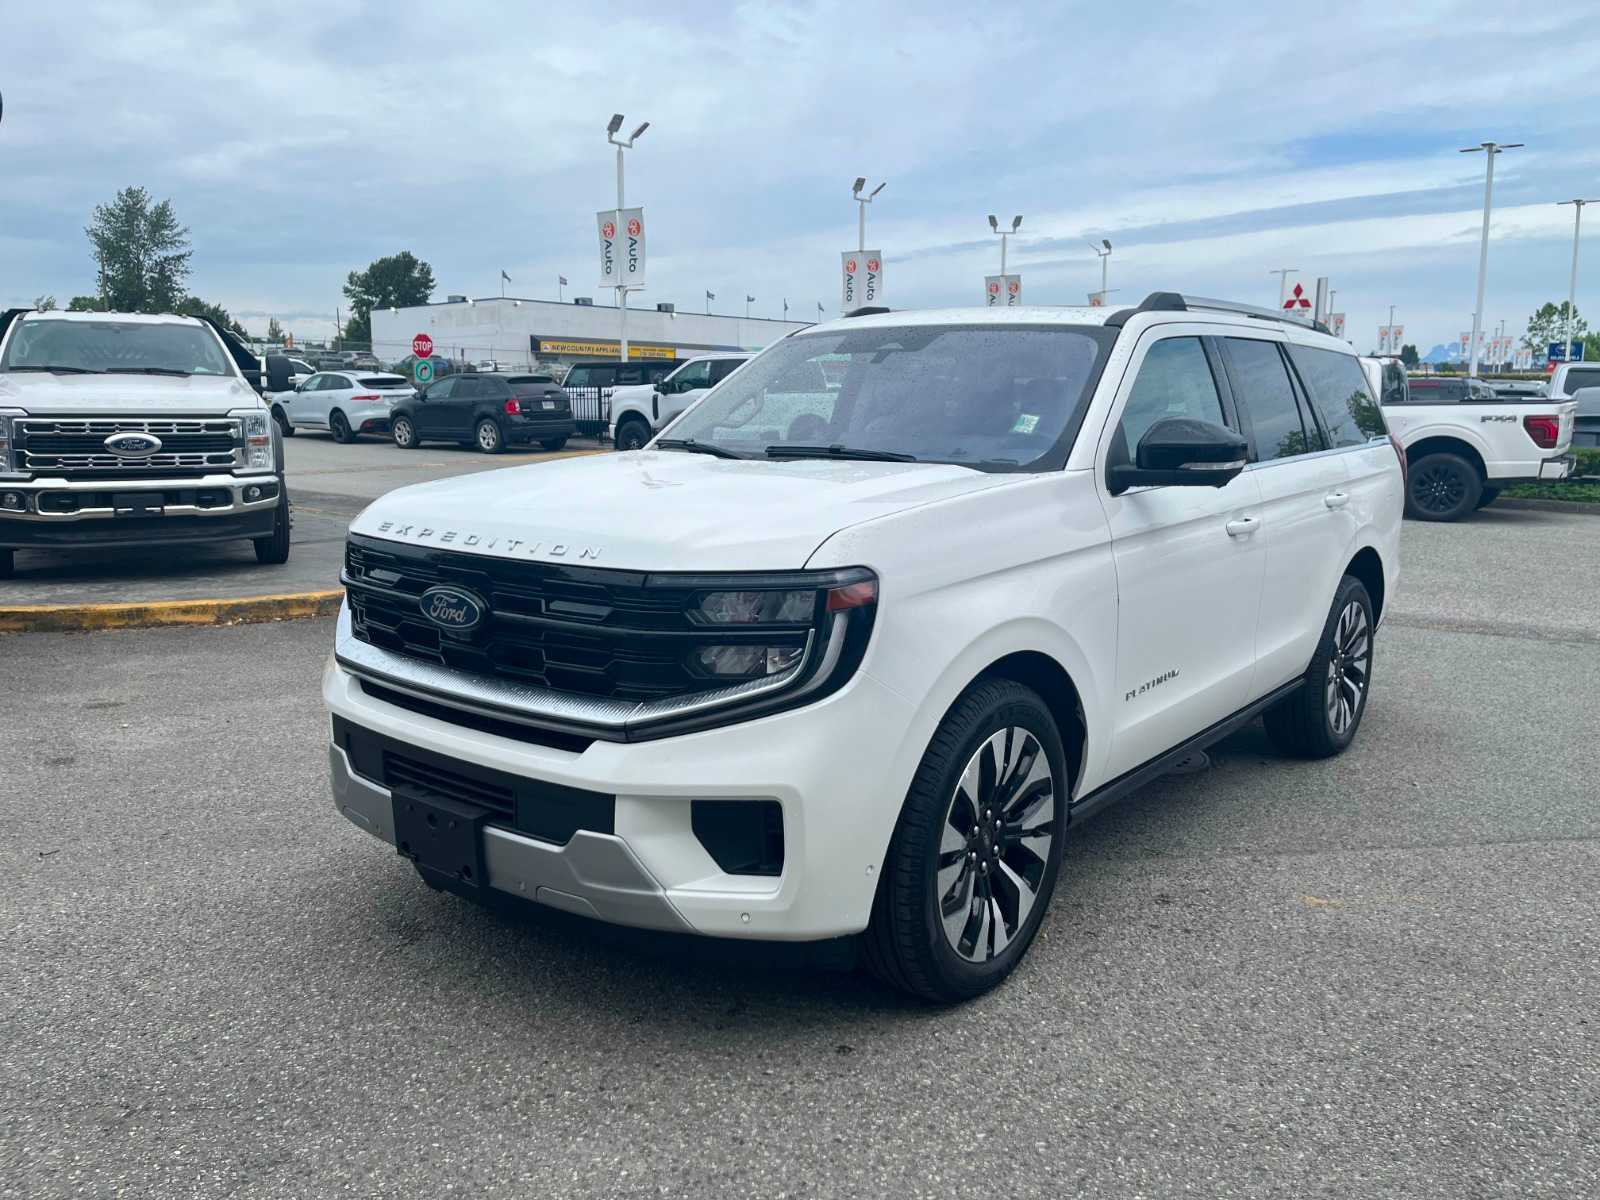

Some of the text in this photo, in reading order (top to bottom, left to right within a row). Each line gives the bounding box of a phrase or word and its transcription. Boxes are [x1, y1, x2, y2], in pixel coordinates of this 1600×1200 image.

[604, 239, 614, 275] Auto
[628, 236, 639, 273] Auto
[846, 273, 854, 302] Auto
[866, 272, 877, 301] Auto
[414, 341, 432, 351] STOP
[377, 522, 602, 560] EXPEDITION
[431, 594, 467, 623] Ford
